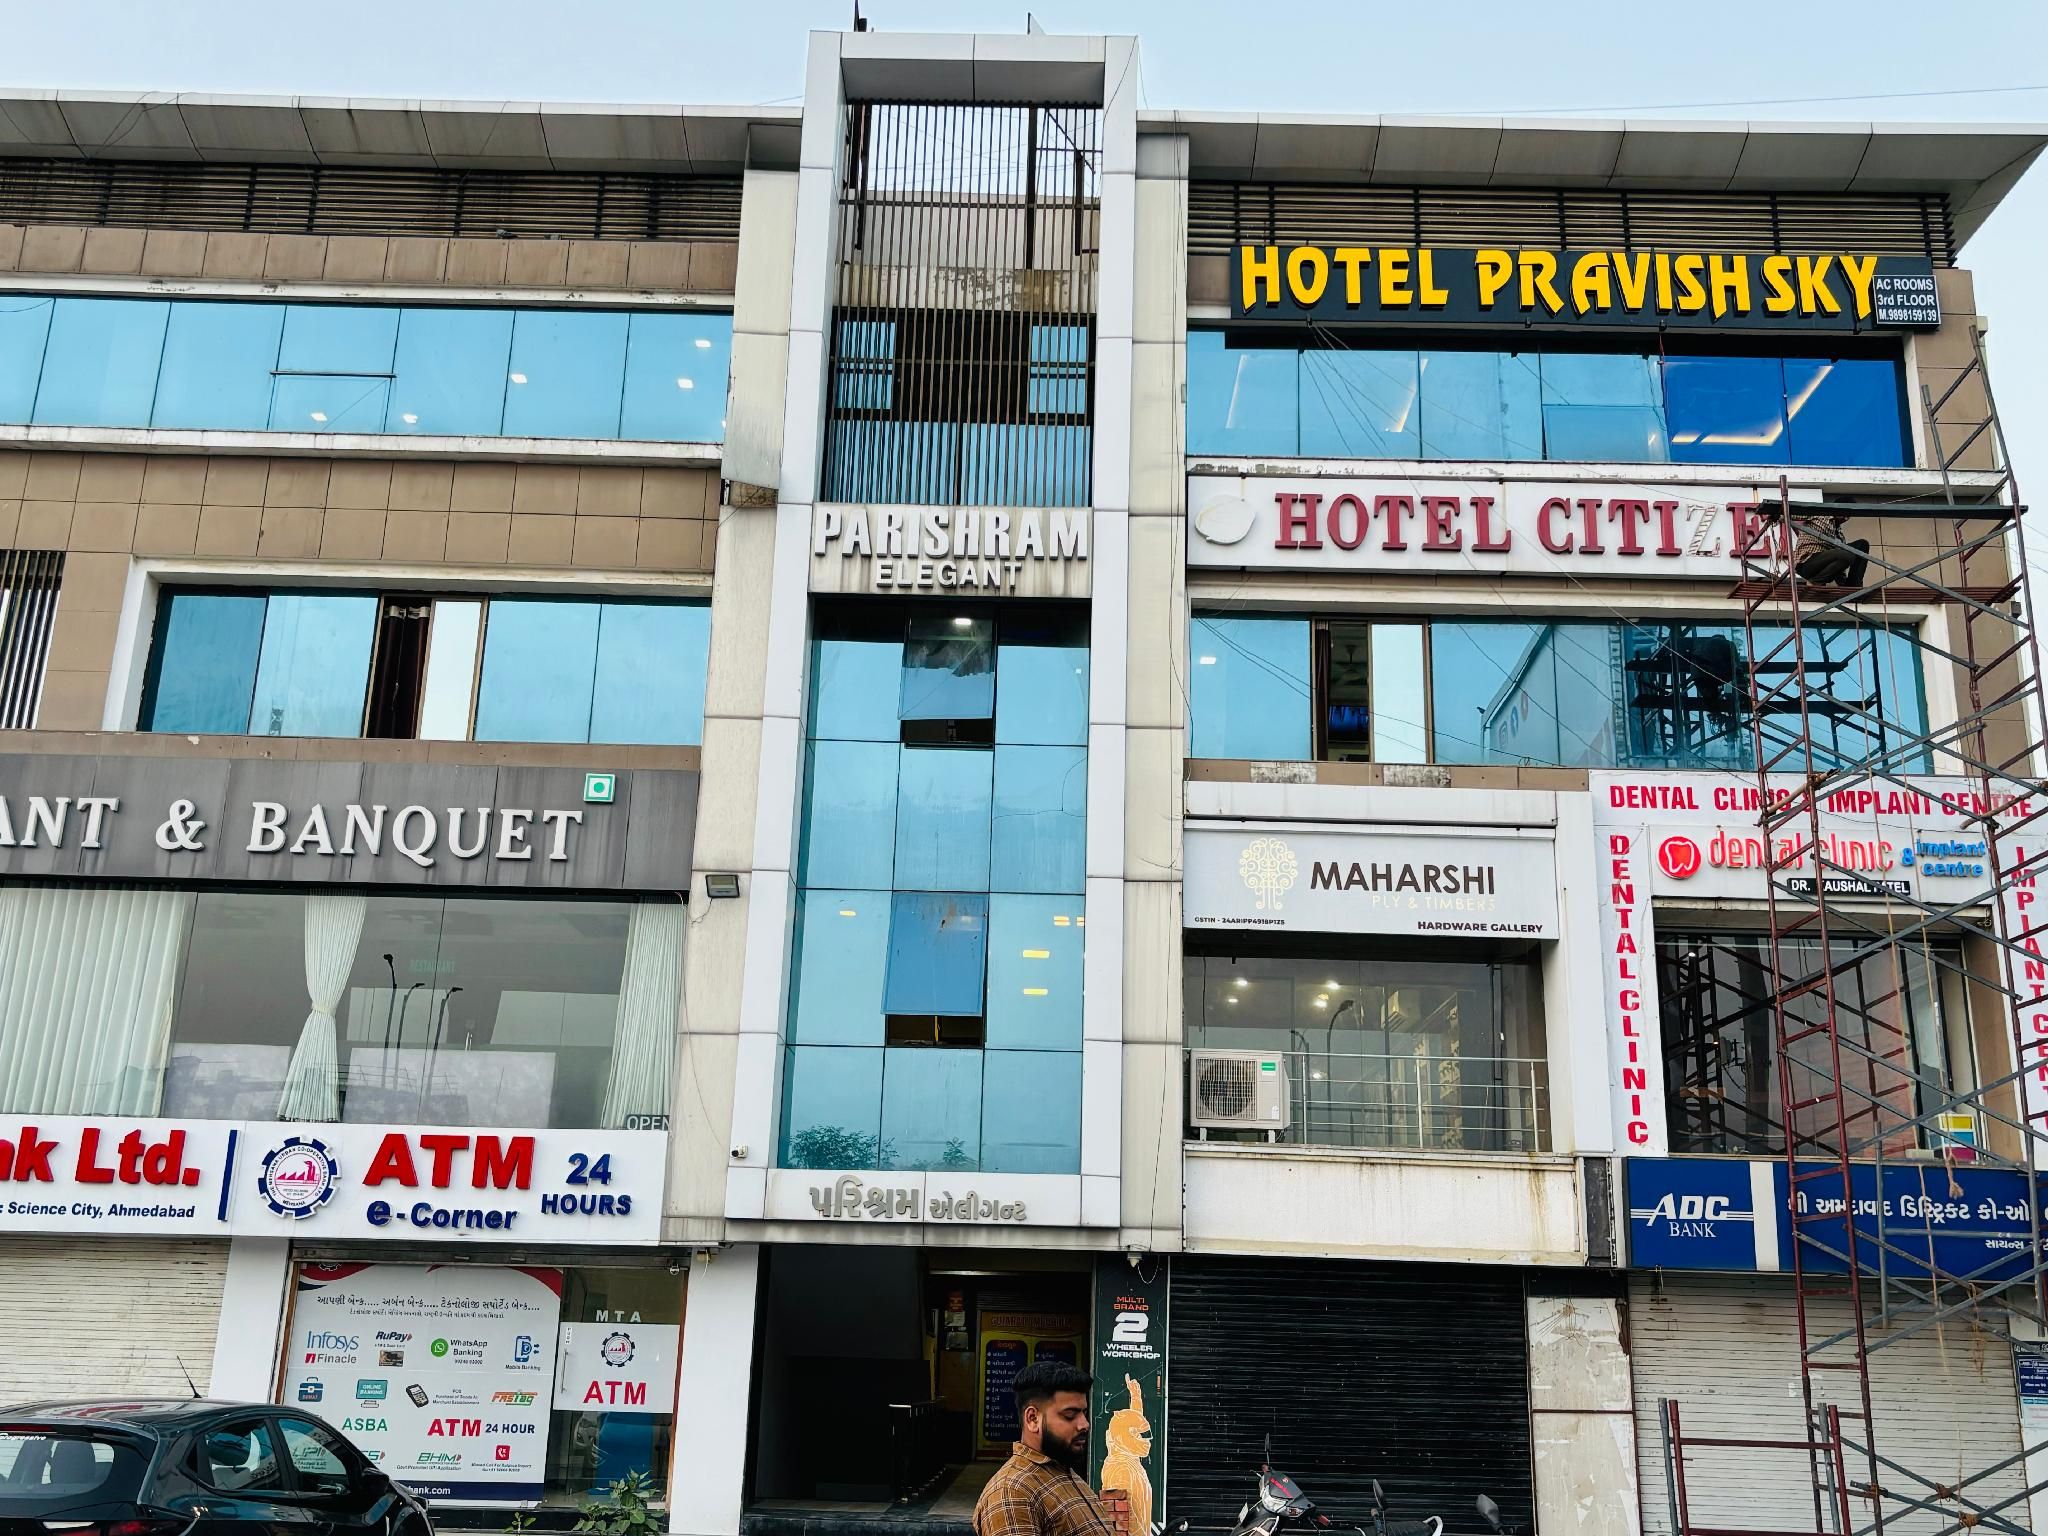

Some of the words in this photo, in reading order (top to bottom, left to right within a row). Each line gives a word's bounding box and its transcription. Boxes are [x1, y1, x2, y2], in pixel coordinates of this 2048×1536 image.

[1241, 245, 1449, 313] HOTEL
[1475, 250, 1750, 320] PRAVISH
[1761, 255, 1878, 320] SKY
[1876, 279, 1891, 290] AC
[1894, 279, 1933, 290] ROOMS
[1877, 294, 1894, 306] 3rd
[1897, 294, 1935, 306] FLOOR
[1879, 308, 1937, 321] M.9898159139
[1275, 493, 1512, 552] HOTEL
[814, 508, 1087, 560] PARISHRAM
[876, 560, 1022, 589] ELEGANT
[1609, 785, 1699, 810] DENTAL
[1828, 790, 1931, 815] IMPLANT
[155, 799, 206, 851] &
[246, 801, 583, 868] BANQUET
[1901, 848, 1916, 867] &
[1916, 838, 1986, 860] implant
[1311, 862, 1495, 894] MAHARSHI
[1921, 861, 1984, 877] centre
[1791, 880, 1811, 891] DR.
[1821, 880, 1871, 892] AUSHAL
[1372, 895, 1401, 908] PLY
[1407, 897, 1419, 909] &
[1425, 896, 1496, 912] TIMBERS
[1609, 834, 1637, 980] DENTAL
[1418, 921, 1488, 932] HARDWARE
[1491, 923, 1543, 933] GALLERY
[1619, 989, 1649, 1144] CLINIC
[627, 1116, 670, 1131] OPEN
[75, 1127, 200, 1187] Ltd.
[362, 1133, 535, 1190] ATM
[566, 1153, 612, 1185] 24
[541, 1194, 633, 1216] HOURS
[809, 1174, 920, 1218] પરિશ્રમ
[930, 1190, 1027, 1221] એલીગન્ટ
[8, 1201, 66, 1216] Science
[71, 1203, 103, 1219] City,
[108, 1203, 195, 1218] Ahmedabad
[366, 1200, 519, 1229] e-Corner
[1646, 1193, 1730, 1226] ADC
[1669, 1222, 1717, 1238] BANK
[376, 1331, 407, 1342] RuPay
[1112, 1312, 1149, 1342] 2
[307, 1331, 359, 1352] Infosys
[450, 1339, 488, 1349] WhatsApp
[1106, 1343, 1153, 1352] WHEELER
[318, 1353, 357, 1364] Finacle
[453, 1348, 483, 1357] Banking
[1102, 1351, 1160, 1359] WORKSHOP
[583, 1380, 647, 1405] ATM
[341, 1418, 388, 1431] ASBA
[427, 1418, 482, 1437] ATM
[485, 1423, 498, 1433] 24
[502, 1424, 535, 1434] HOUR
[417, 1452, 457, 1462] BHIM
